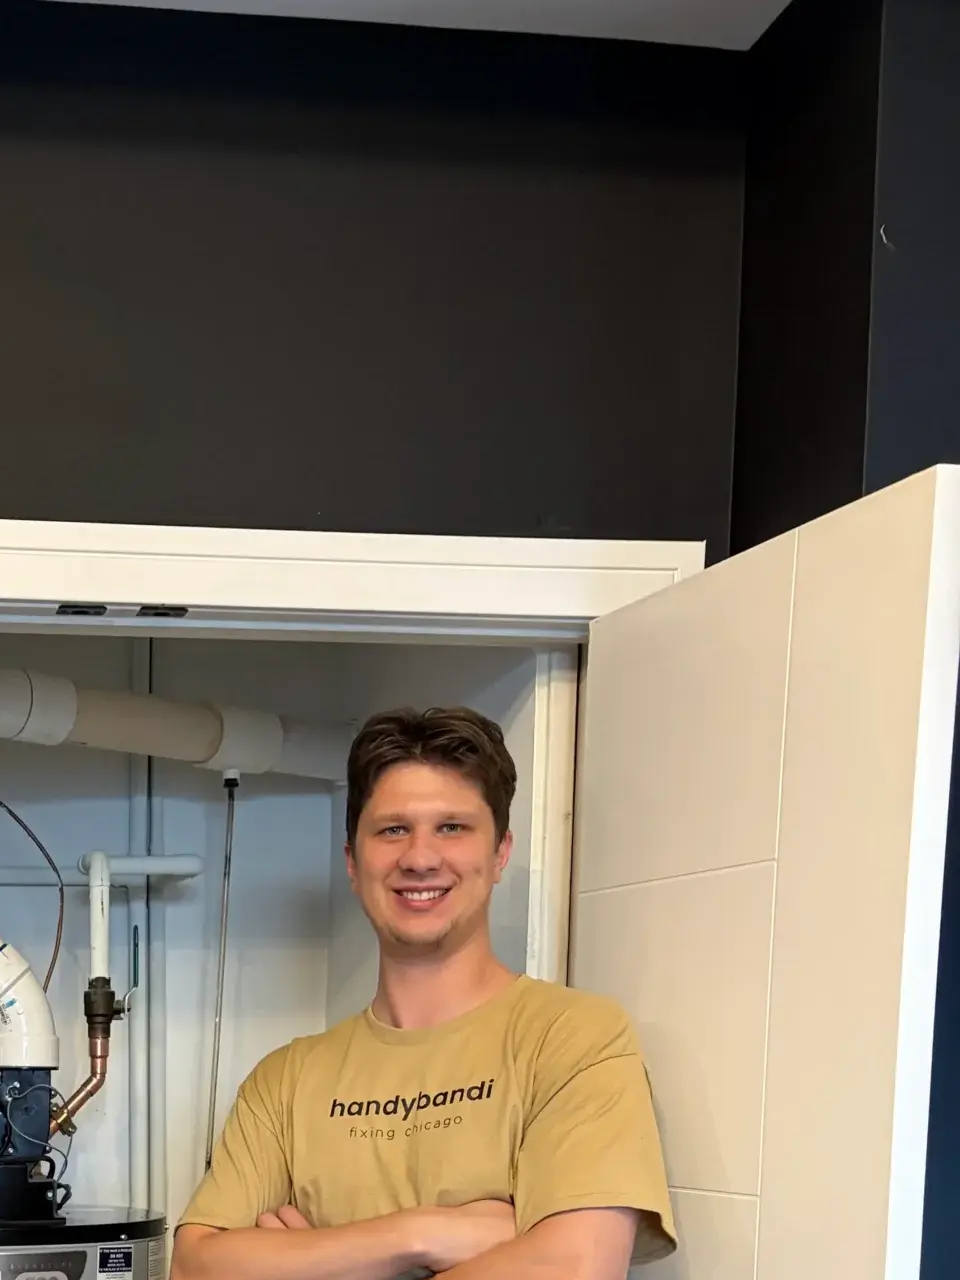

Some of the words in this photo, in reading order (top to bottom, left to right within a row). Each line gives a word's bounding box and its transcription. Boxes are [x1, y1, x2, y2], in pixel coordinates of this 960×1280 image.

[329, 1078, 495, 1121] handybandi
[349, 1126, 396, 1141] fixing
[404, 1115, 463, 1137] chicago
